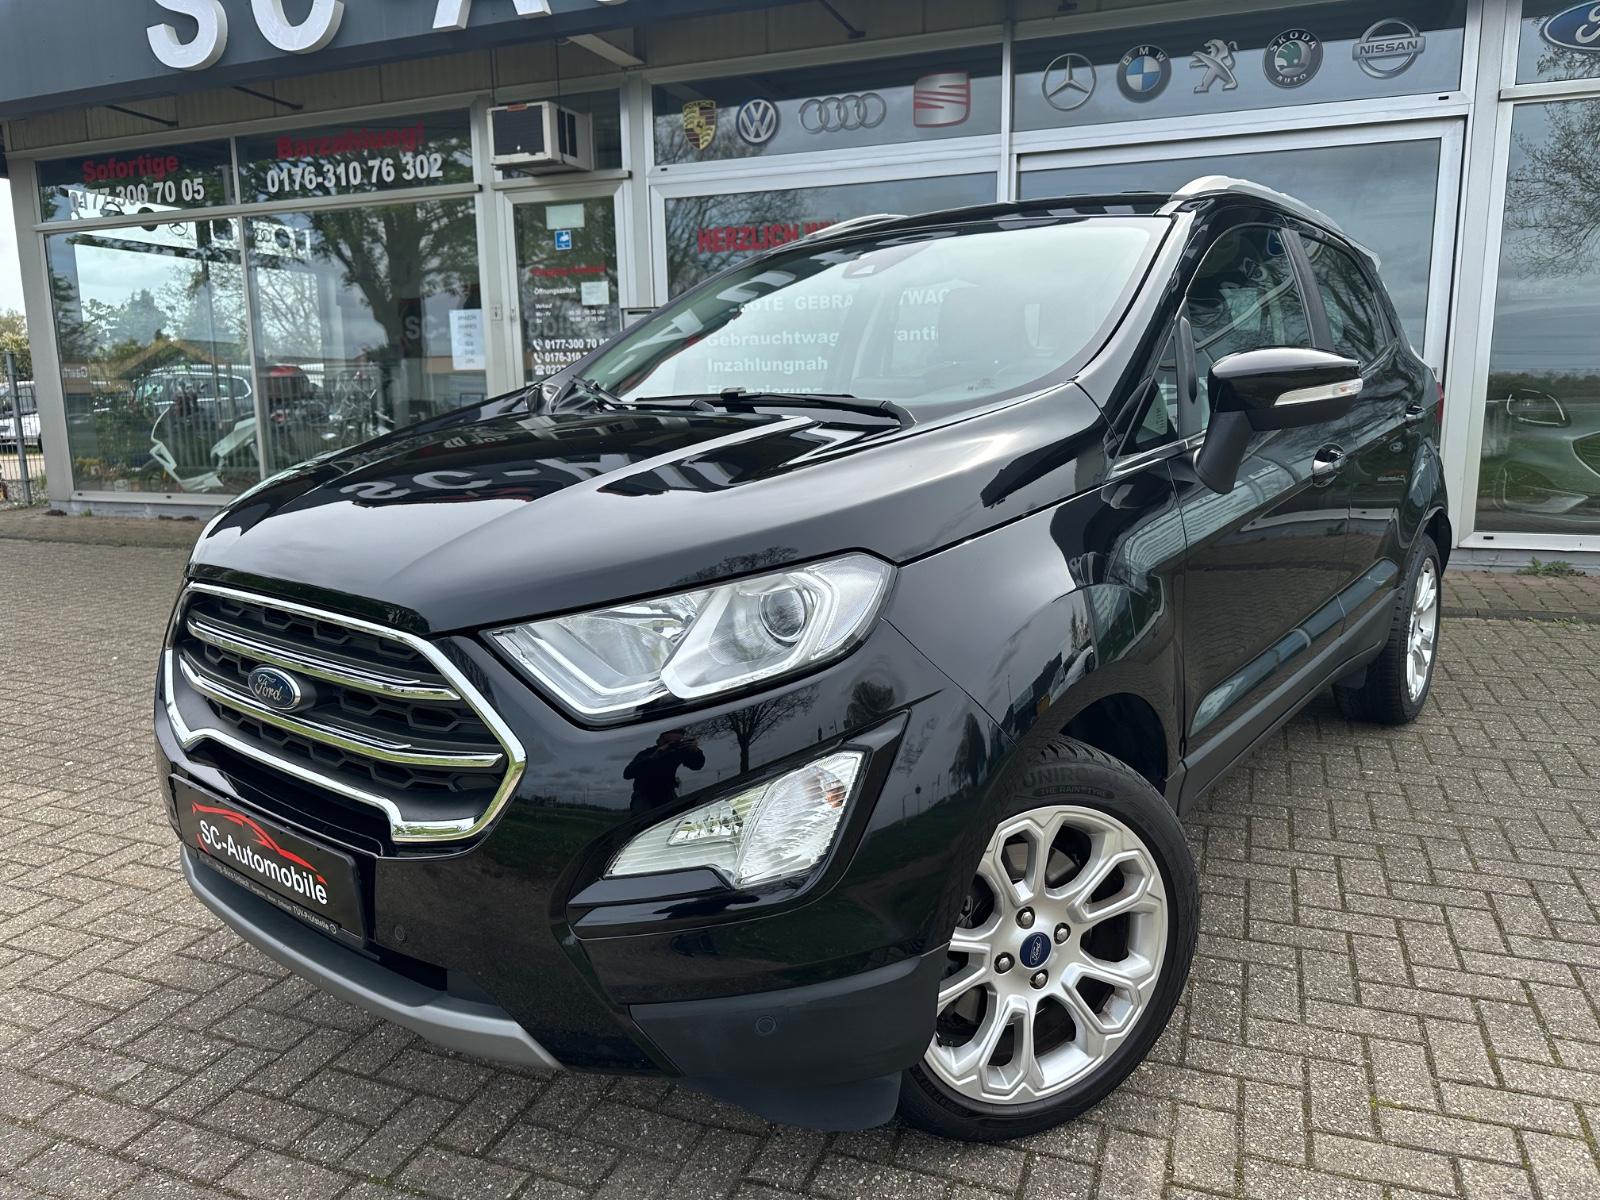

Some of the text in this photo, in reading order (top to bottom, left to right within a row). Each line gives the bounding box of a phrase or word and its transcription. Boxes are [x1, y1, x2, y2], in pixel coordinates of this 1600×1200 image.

[1270, 31, 1317, 52] SKODA
[1360, 40, 1418, 56] NISSAN
[1122, 46, 1165, 66] BMW
[1277, 73, 1307, 83] AUTO
[276, 121, 425, 160] Barzahlung!
[82, 155, 179, 183] Sofortige
[266, 153, 443, 193] 0176-310 76 302
[153, 180, 176, 204] 70
[182, 178, 205, 201] 05
[697, 223, 799, 252] HERZLICH
[544, 339, 584, 349] 0177-300
[586, 338, 597, 349] 70
[544, 352, 582, 362] 0176-310
[254, 673, 285, 702] Ford
[1059, 786, 1082, 794] RAIN
[200, 819, 328, 905] SC-Automobile
